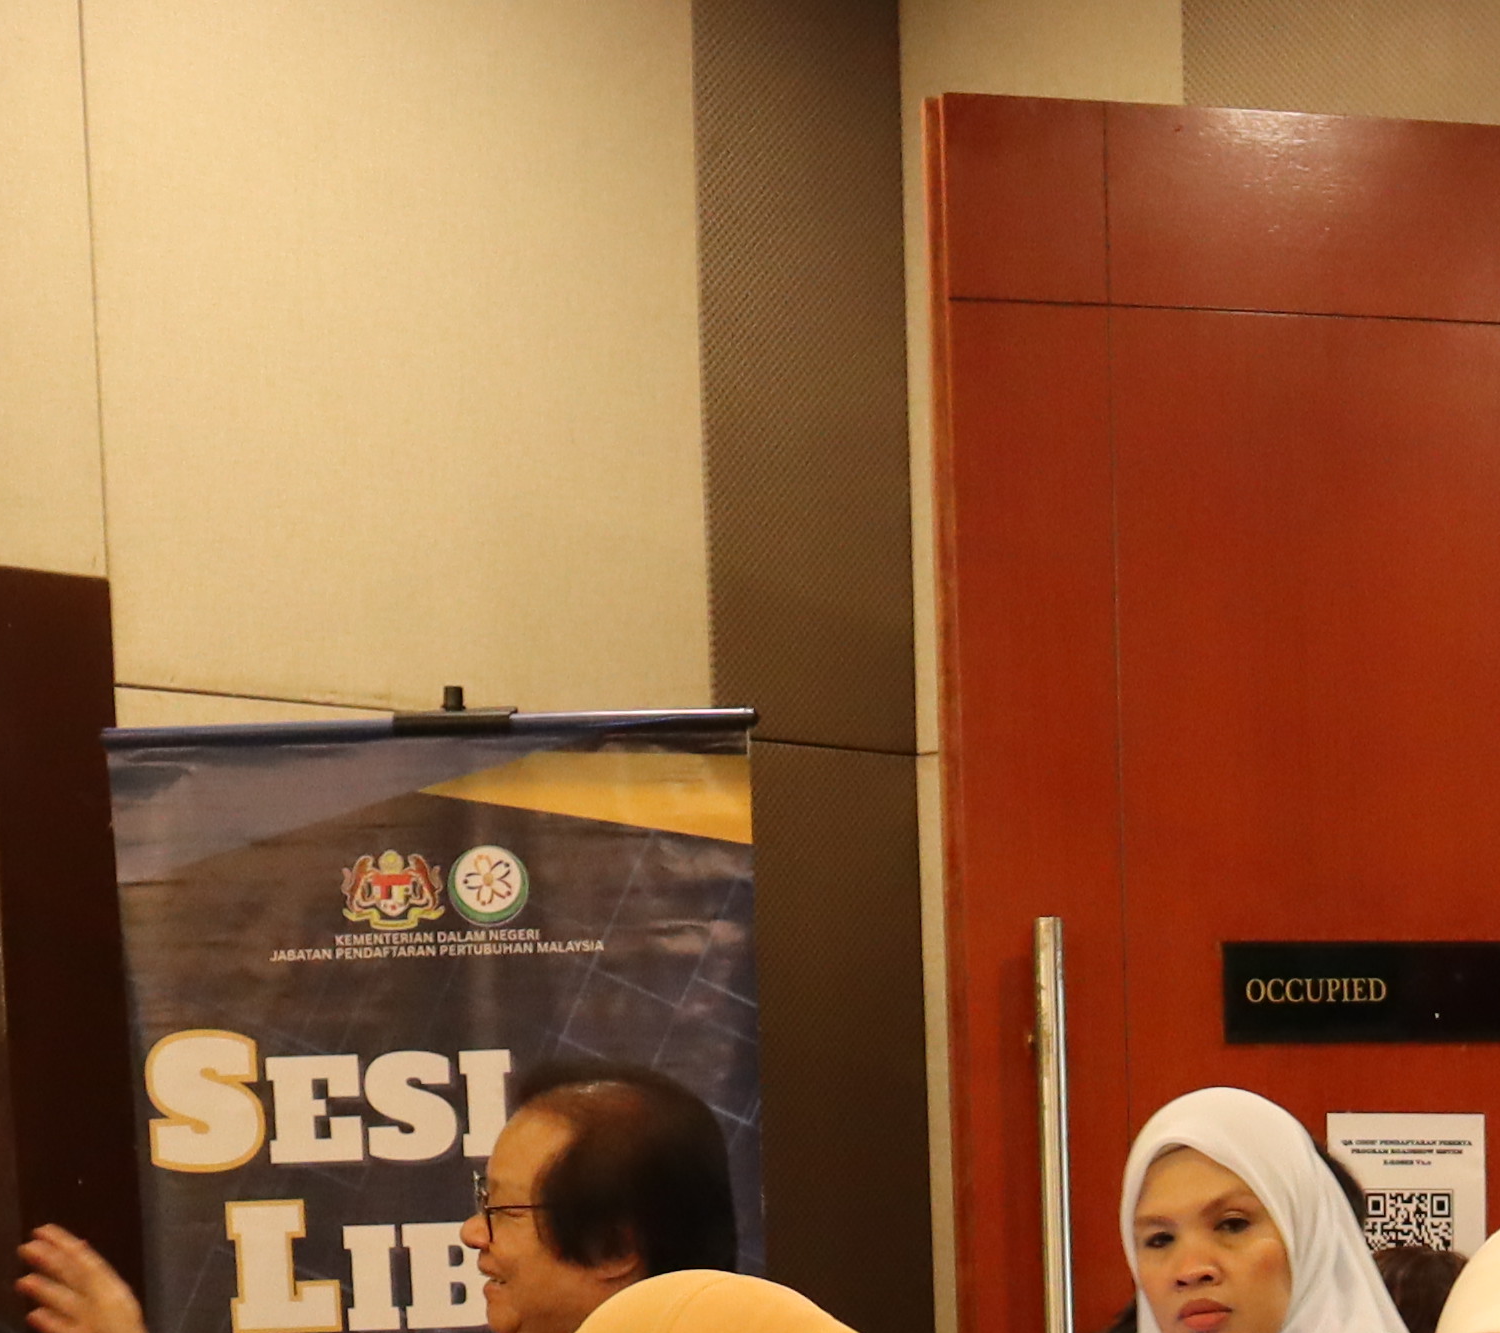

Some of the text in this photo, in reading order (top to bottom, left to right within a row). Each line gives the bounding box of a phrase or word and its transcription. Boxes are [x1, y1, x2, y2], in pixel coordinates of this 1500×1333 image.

[334, 928, 541, 947] KEMENTERIAN DALAM NEGERI
[269, 939, 605, 962] JABATAN PENDAFTARAN PERTUBUHAN MALAYSIA
[1245, 977, 1387, 1003] OCCUPIED
